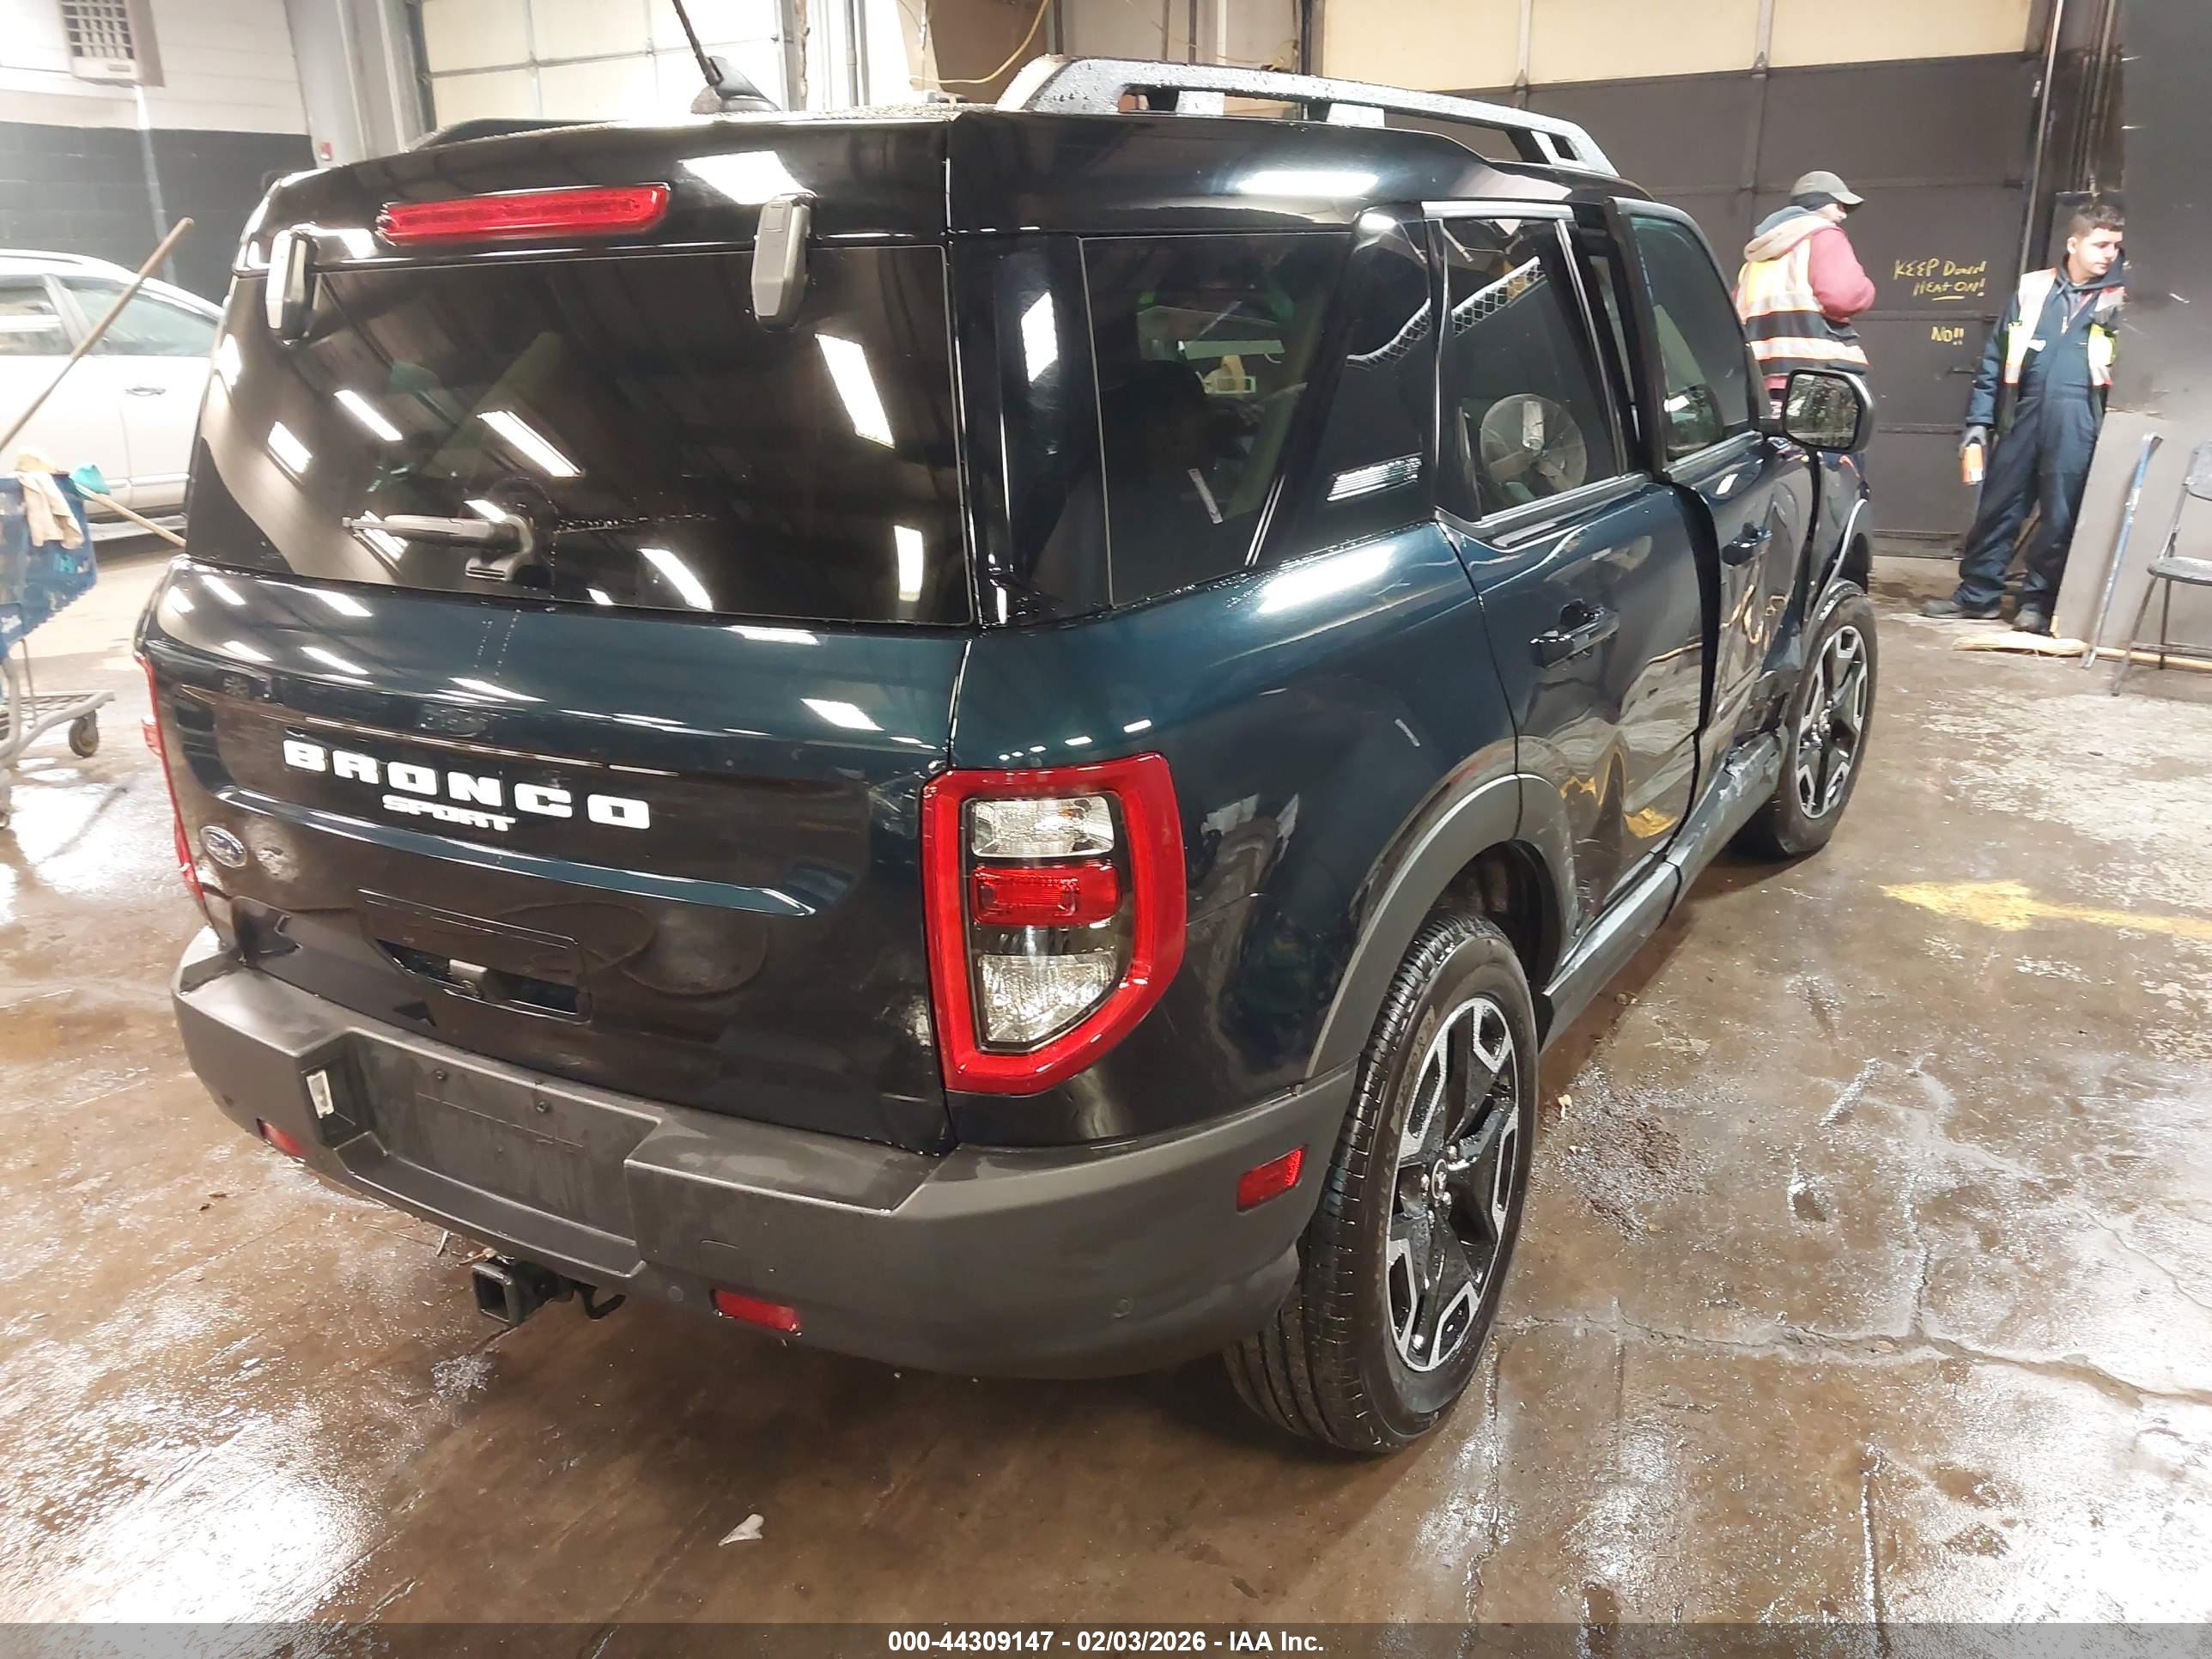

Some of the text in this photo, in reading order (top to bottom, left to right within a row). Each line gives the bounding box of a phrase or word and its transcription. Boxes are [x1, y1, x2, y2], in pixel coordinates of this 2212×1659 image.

[1893, 258, 1940, 280] KEEP
[283, 739, 651, 830] BRONCO
[381, 794, 518, 832] SPORT
